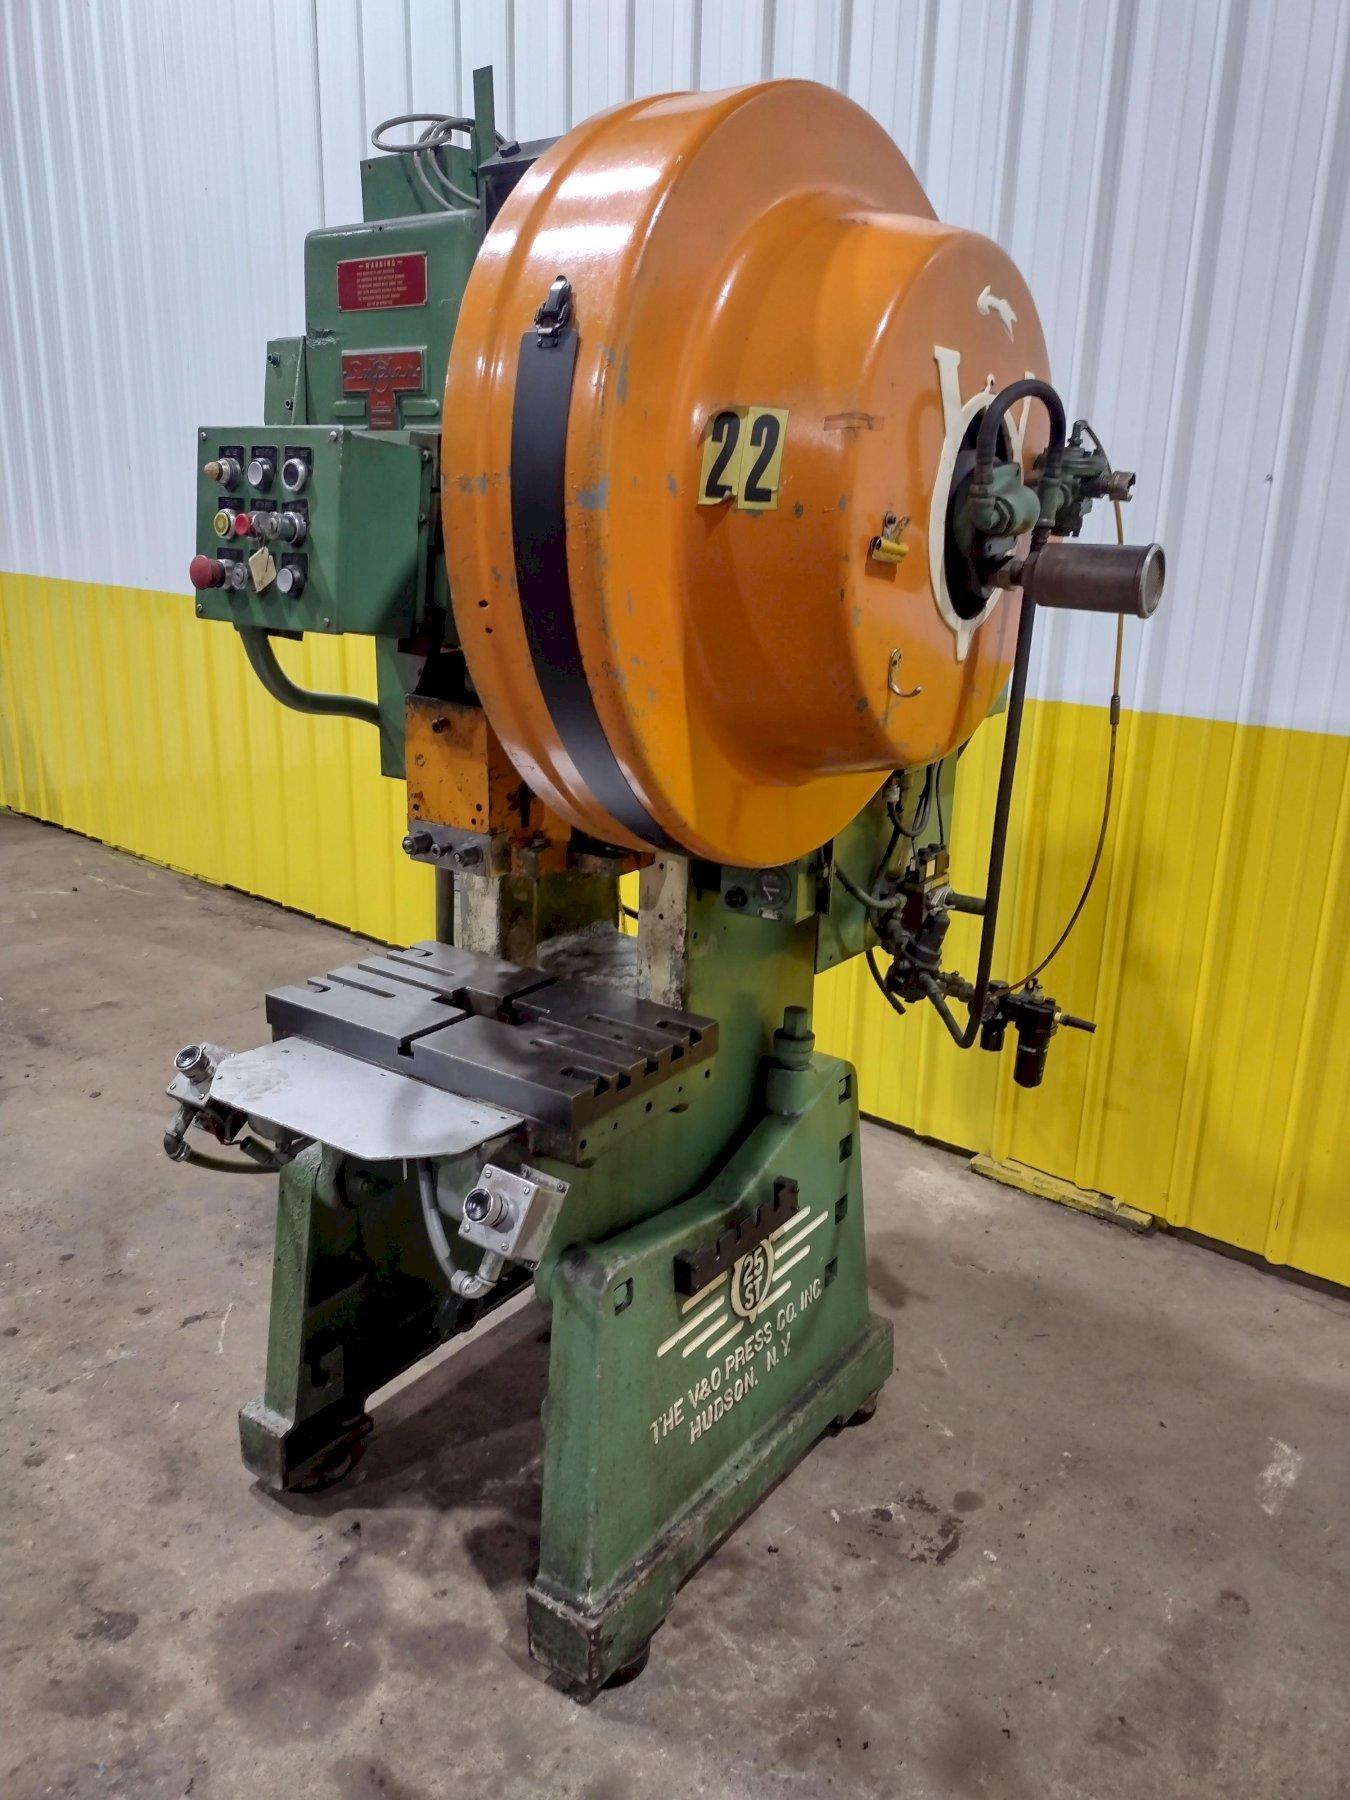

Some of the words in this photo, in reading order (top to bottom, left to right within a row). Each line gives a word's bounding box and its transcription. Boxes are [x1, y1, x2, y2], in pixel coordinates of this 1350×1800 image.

[743, 1246, 765, 1286] 25
[744, 1275, 763, 1310] ST
[650, 1397, 685, 1445] THE
[688, 1367, 722, 1409] V&O
[725, 1321, 773, 1380] PRESS
[776, 1302, 798, 1332] CO.
